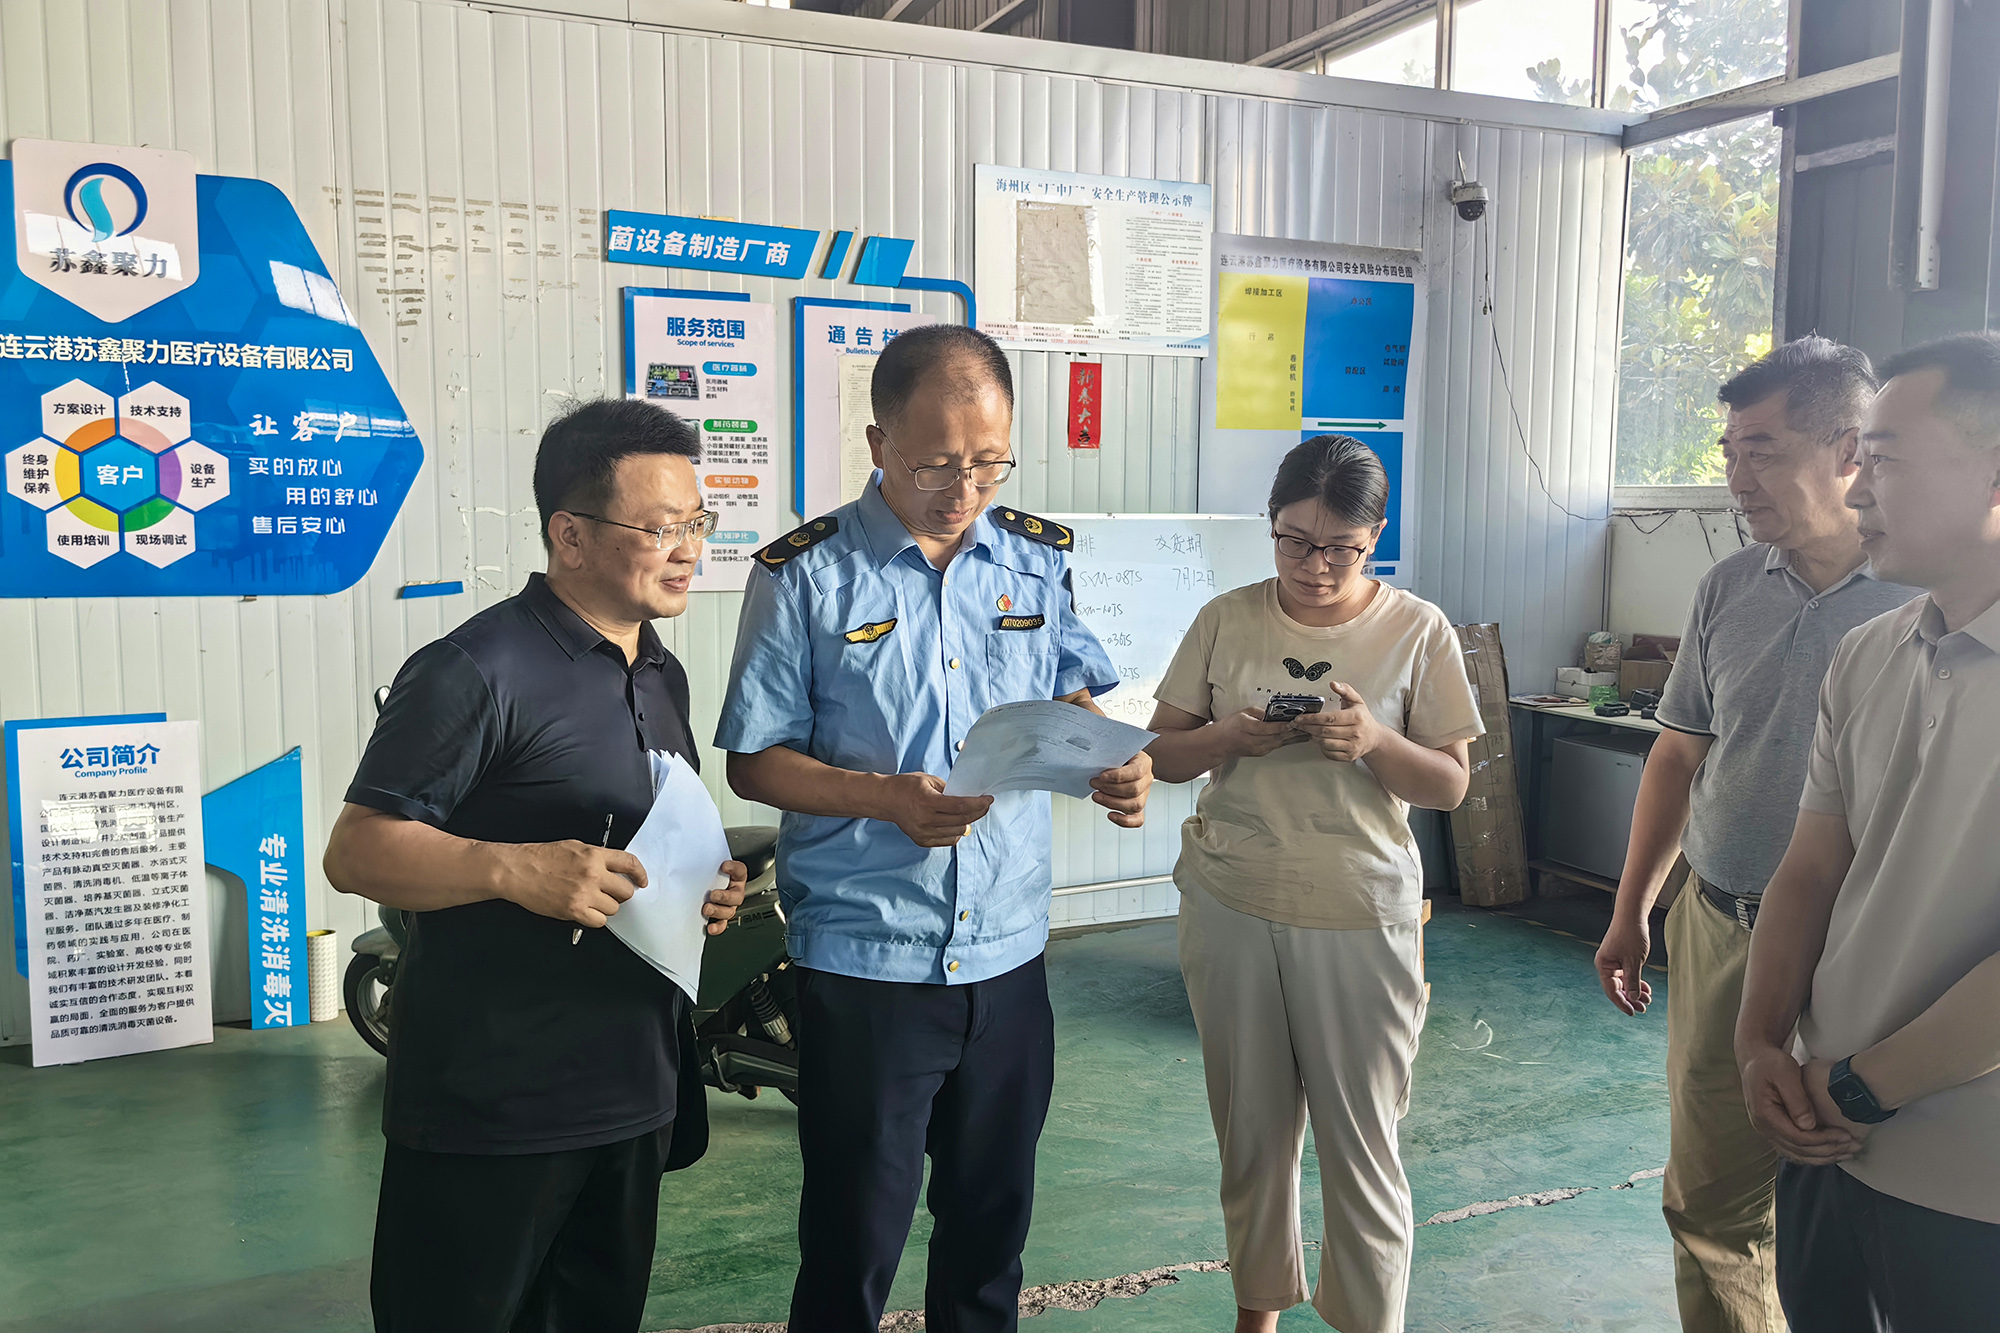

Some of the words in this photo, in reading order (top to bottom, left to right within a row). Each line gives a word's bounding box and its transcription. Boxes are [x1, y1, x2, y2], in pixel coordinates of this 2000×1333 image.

[608, 225, 791, 266] 菌设备制造厂商
[49, 247, 168, 279] 苏鑫聚力
[666, 316, 745, 340] 服务范围
[677, 338, 698, 348] Scope
[699, 339, 707, 347] of
[707, 340, 735, 348] services
[0, 333, 354, 373] 连云港苏鑫聚力医疗设备有限公司
[845, 347, 870, 355] Bulletin
[712, 363, 748, 372] 医疗器械
[53, 403, 107, 416] 方案设计
[130, 404, 182, 418] 技术支持
[249, 411, 359, 443] 让客户
[22, 453, 48, 466] 终身
[249, 457, 343, 476] 买的放心
[23, 467, 50, 481] 维护
[96, 464, 144, 486] 客户
[190, 463, 216, 475] 设备
[190, 476, 216, 489] 生产
[714, 476, 749, 485] 实验动物
[24, 482, 51, 495] 保养
[286, 487, 378, 506] 用的舒心
[252, 516, 346, 535] 售后安心
[57, 533, 110, 547] 使用培训
[135, 533, 188, 547] 现场调试
[1155, 533, 1203, 558] 交货期
[60, 743, 161, 769] 公司简介
[74, 767, 118, 779] Company
[119, 766, 148, 776] Profile
[258, 833, 293, 1027] 专业清洗消毒灭
